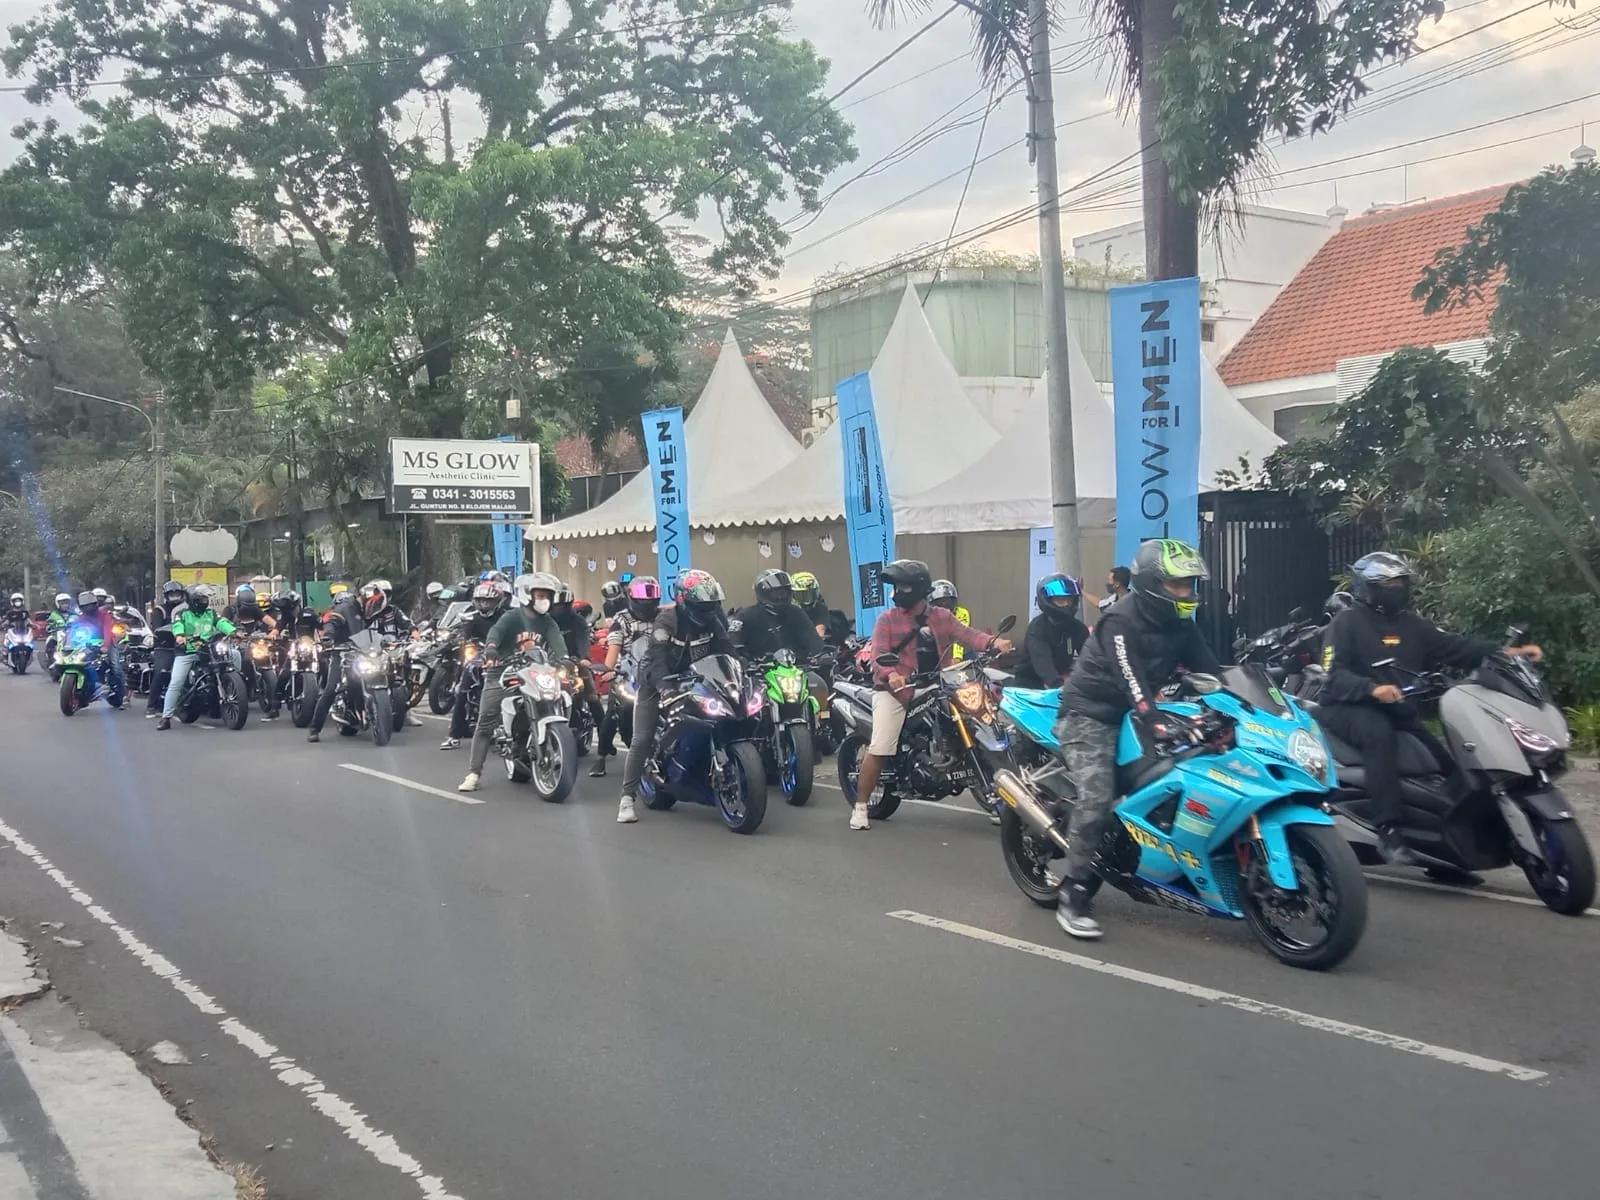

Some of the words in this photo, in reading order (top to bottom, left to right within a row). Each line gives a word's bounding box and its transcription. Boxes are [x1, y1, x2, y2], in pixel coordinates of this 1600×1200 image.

[1140, 299, 1170, 413] MEN
[1141, 416, 1169, 430] FOR
[402, 450, 439, 469] MS
[445, 452, 521, 471] GLOW
[656, 420, 676, 495] MEN
[428, 472, 468, 480] Aesthetic
[470, 473, 496, 481] Clinic
[432, 488, 460, 500] 0341
[469, 489, 516, 501] 3015563
[1140, 437, 1170, 543] LOW
[661, 497, 676, 506] FOR
[869, 569, 879, 598] MEN
